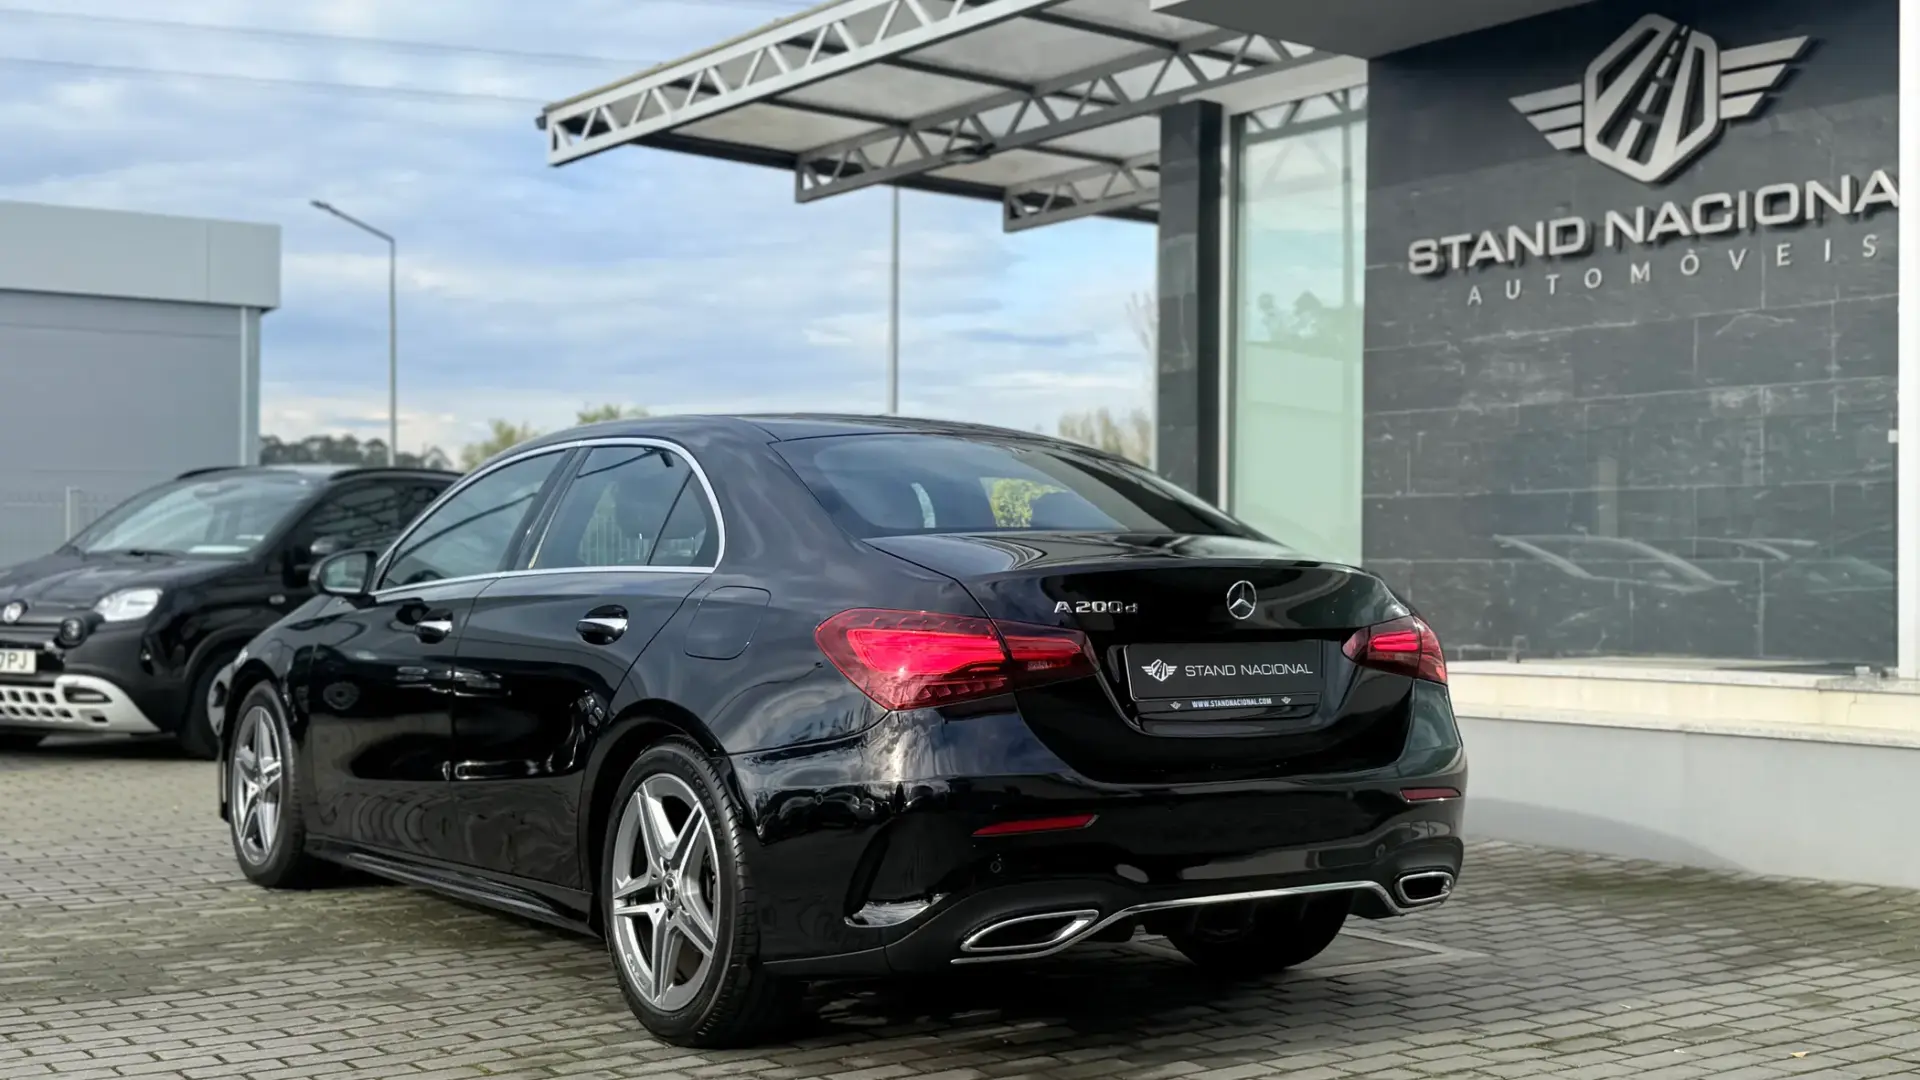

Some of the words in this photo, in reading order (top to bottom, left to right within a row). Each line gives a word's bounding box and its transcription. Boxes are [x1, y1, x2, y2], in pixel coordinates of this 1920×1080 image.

[1408, 215, 1586, 275] STAND
[1053, 601, 1073, 614] A
[1075, 601, 1138, 614] 200d
[1184, 664, 1237, 677] STAND
[1240, 663, 1314, 676] NACIONAL
[1191, 697, 1273, 709] WWW.STANDNACIONAL.COM
